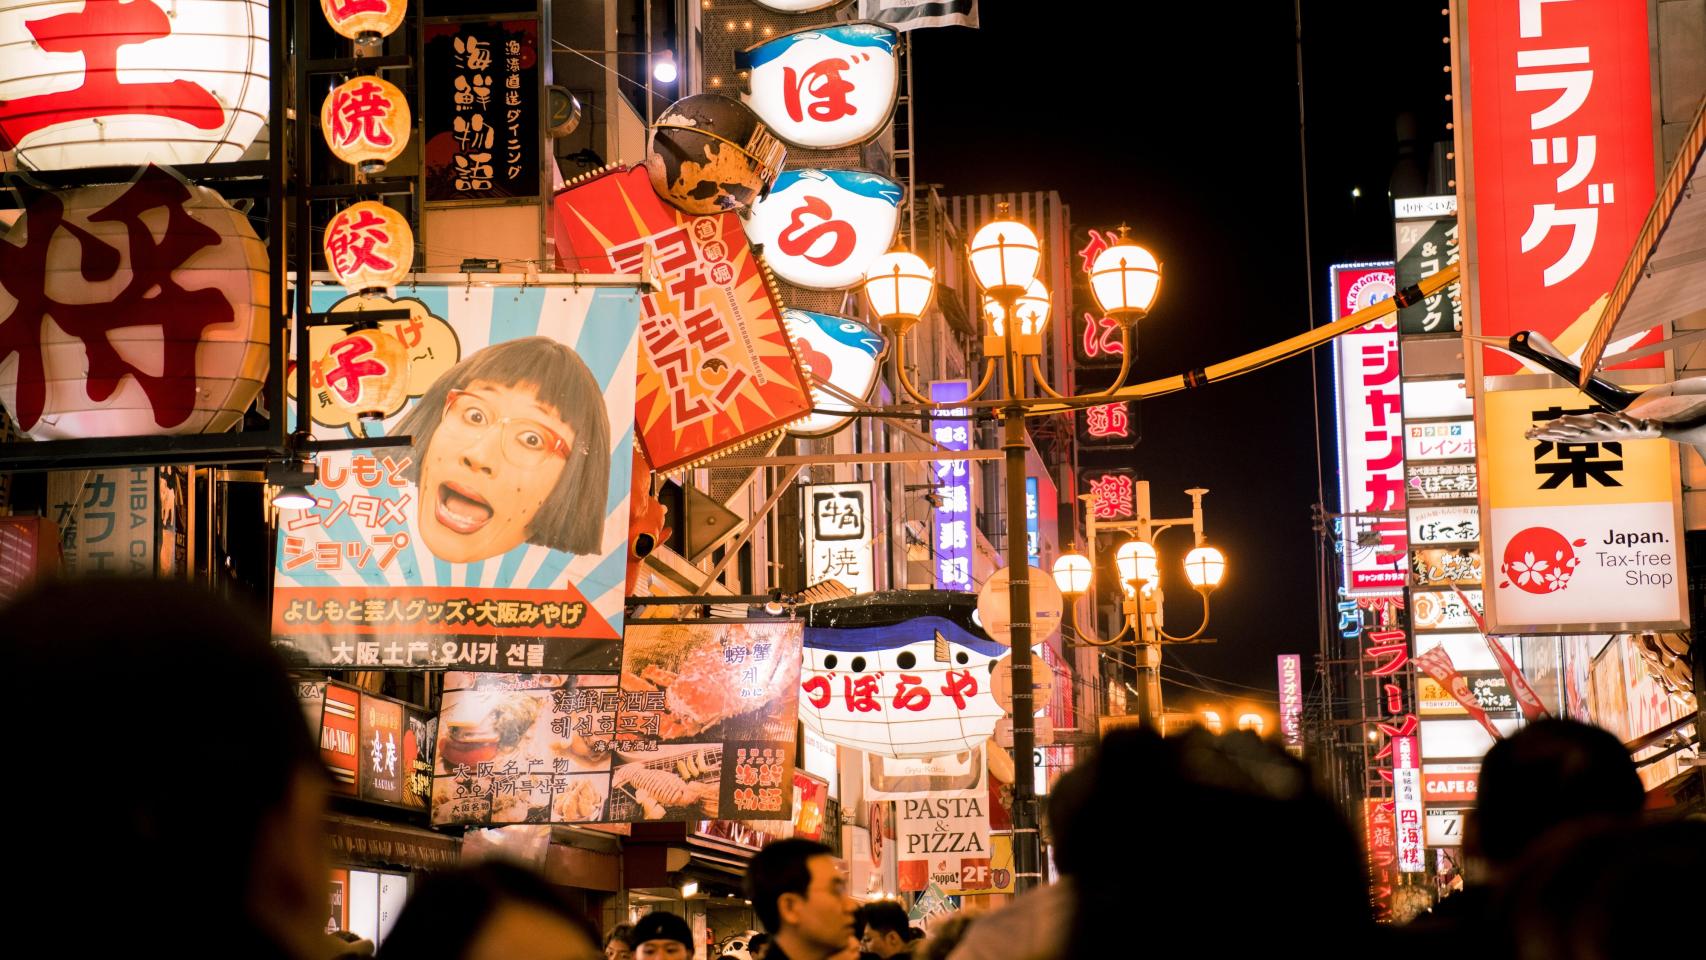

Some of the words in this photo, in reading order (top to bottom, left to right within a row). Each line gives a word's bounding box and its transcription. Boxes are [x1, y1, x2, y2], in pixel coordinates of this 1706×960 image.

[328, 81, 393, 147] 焼
[453, 35, 495, 191] 海鮮物語
[327, 210, 395, 277] 餃
[326, 335, 387, 404] 子
[1361, 340, 1408, 566] ジャンカラ
[312, 454, 413, 492] しもと
[820, 500, 861, 530] 牛角
[1603, 528, 1670, 550] Japan.
[283, 532, 411, 572] ショップ
[1596, 550, 1672, 567] Tax-free
[1625, 570, 1673, 588] Shop
[284, 600, 585, 629] よしもと芸人グッズ・大阪みやげ
[505, 643, 545, 668] 선물
[552, 690, 667, 713] 海鮮居酒屋
[801, 668, 979, 713] づぼらや
[551, 714, 662, 739] 해선호프집
[1426, 780, 1465, 794] CAFE
[903, 797, 985, 820] PASTA
[934, 820, 950, 832] &
[906, 831, 985, 854] PIZZA
[963, 866, 988, 883] 2F
